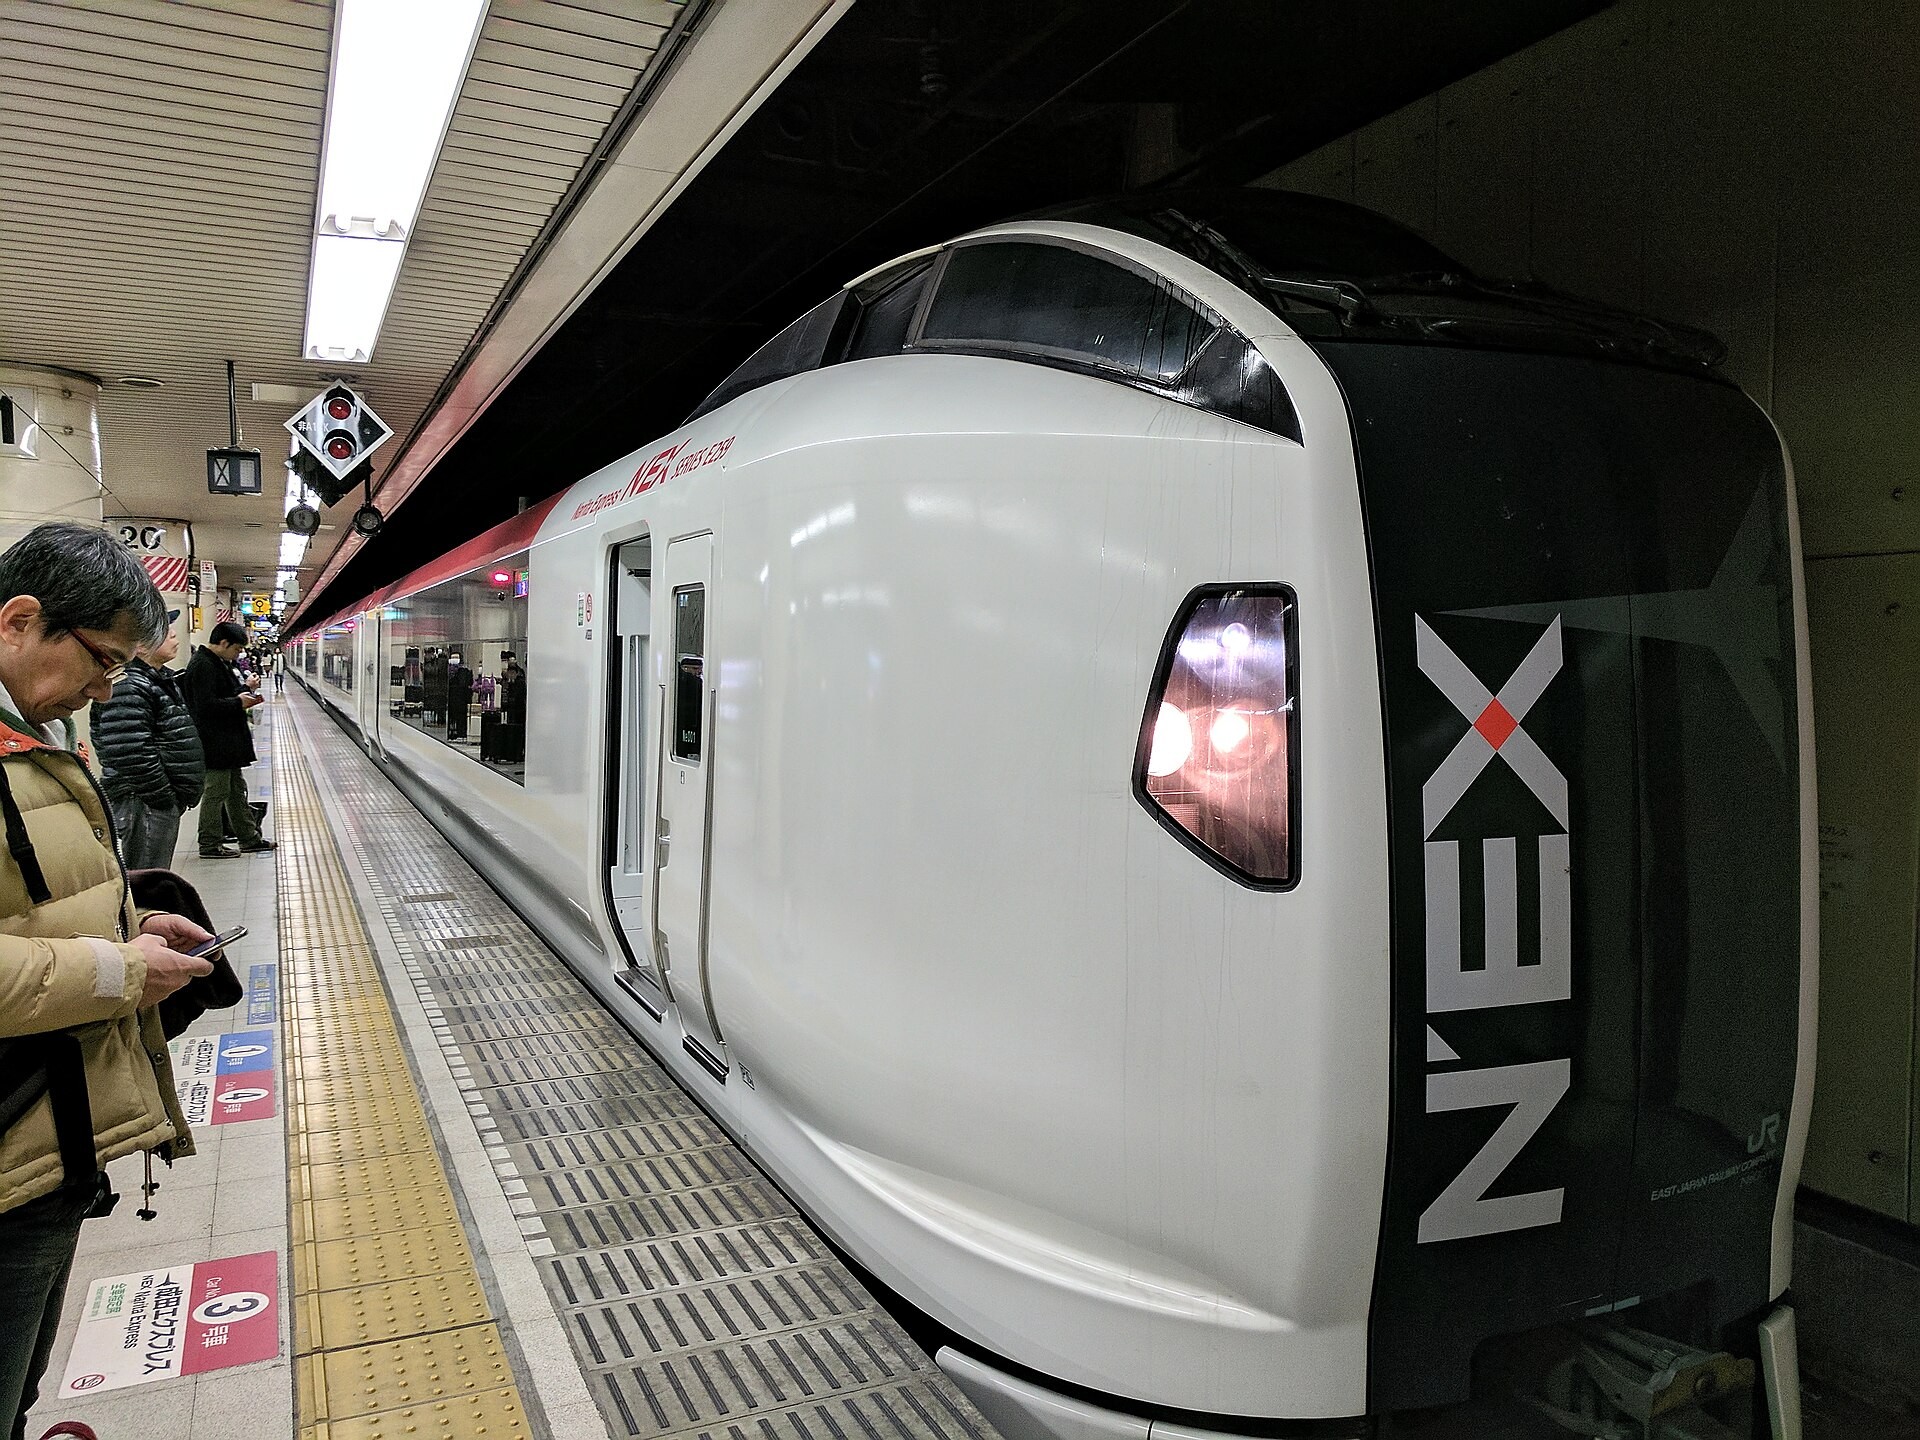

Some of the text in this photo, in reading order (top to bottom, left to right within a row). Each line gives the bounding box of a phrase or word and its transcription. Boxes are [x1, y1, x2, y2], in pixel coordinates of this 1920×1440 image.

[670, 447, 708, 480] SERIES
[702, 436, 737, 467] E259
[120, 525, 161, 550] 20
[228, 1047, 262, 1055] 1
[225, 1092, 262, 1101] 4
[1747, 1112, 1781, 1154] JR
[1651, 1185, 1677, 1201] EAST
[1676, 1176, 1708, 1195] JAPAN
[205, 1277, 223, 1288] Car
[131, 1290, 151, 1315] Narita
[203, 1298, 260, 1319] 3
[123, 1314, 147, 1349] Express
[142, 1286, 184, 1375] 成田エクスプレス
[202, 1325, 229, 1349] 号車
